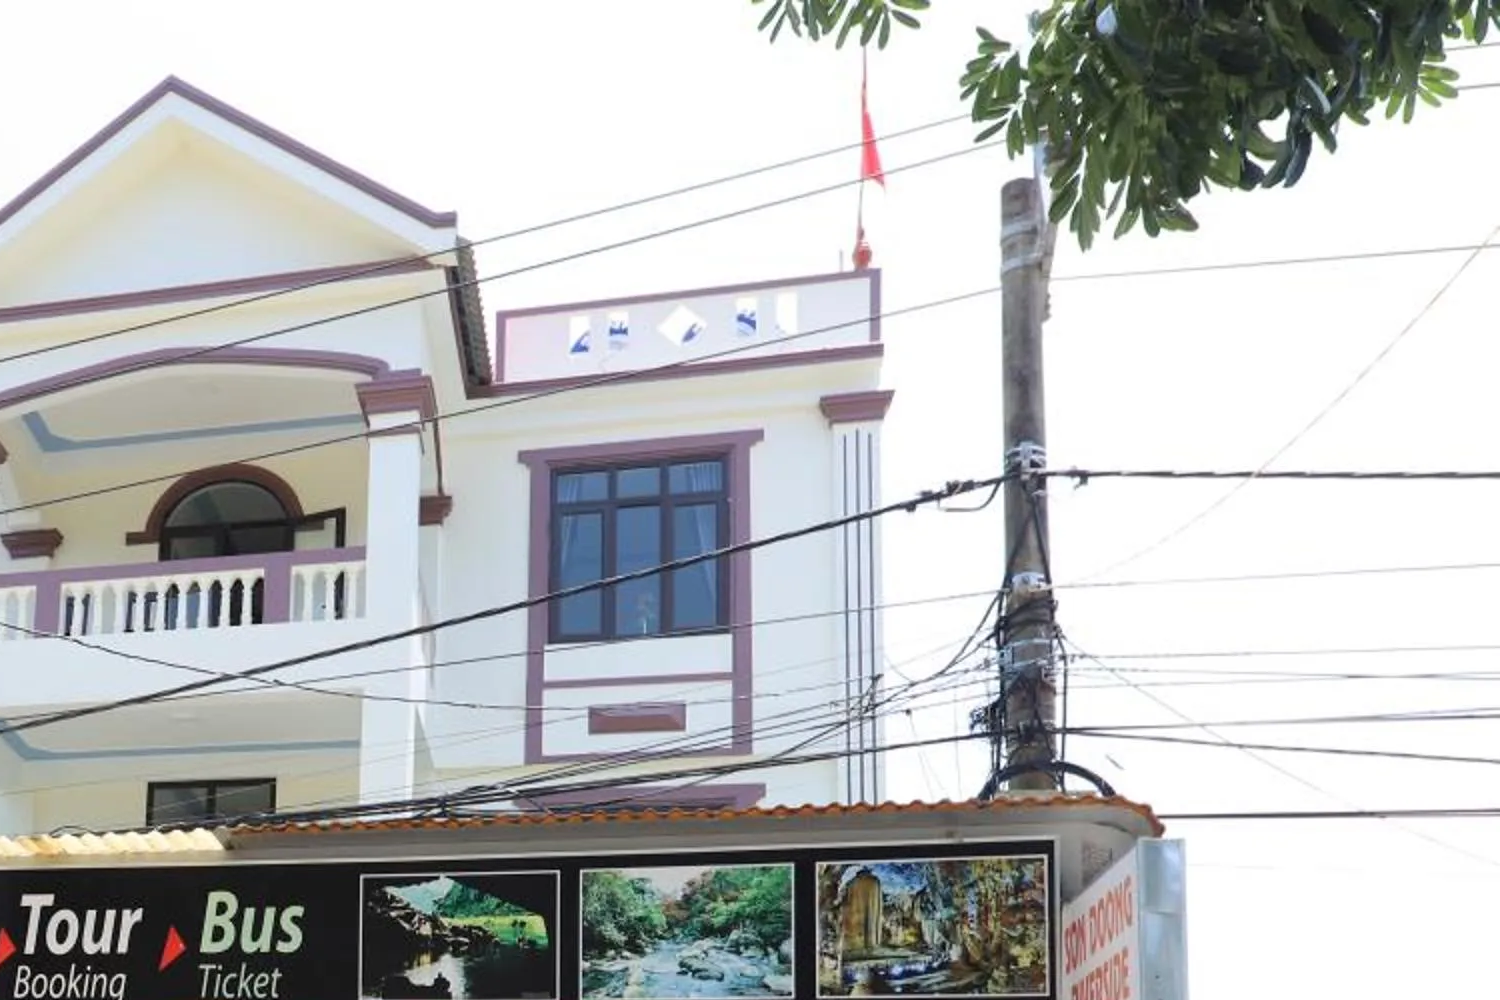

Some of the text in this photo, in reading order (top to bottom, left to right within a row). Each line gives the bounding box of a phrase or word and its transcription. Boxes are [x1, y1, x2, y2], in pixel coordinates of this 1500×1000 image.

[20, 893, 143, 955] Tour
[200, 891, 305, 954] Bus
[1064, 875, 1133, 974] SON DOONG
[199, 962, 283, 999] Ticket
